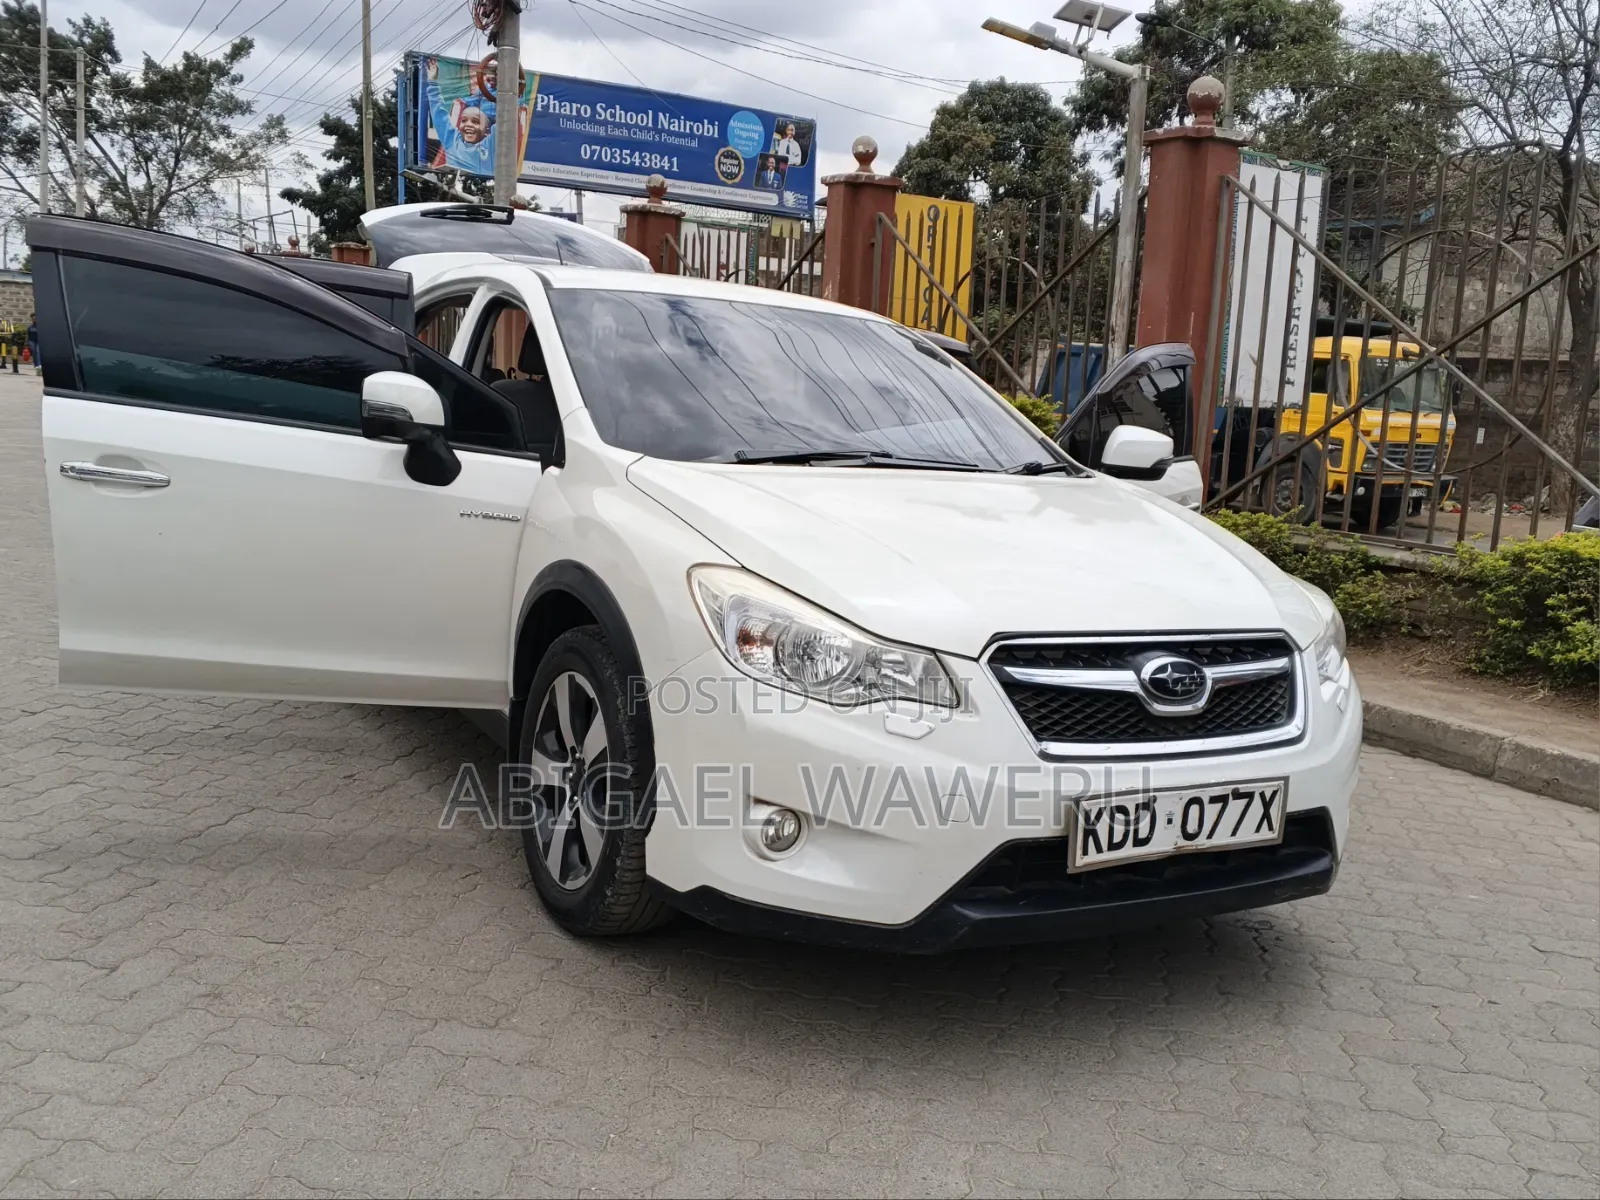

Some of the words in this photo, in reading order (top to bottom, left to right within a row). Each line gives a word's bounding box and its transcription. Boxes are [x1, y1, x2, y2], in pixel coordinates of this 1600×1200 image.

[536, 93, 591, 118] Pharo
[596, 102, 653, 127] School
[657, 111, 720, 138] Nairobi
[729, 119, 763, 131] Admissions
[559, 117, 606, 136] Unlocking
[607, 124, 629, 137] Each
[630, 127, 660, 142] Child's
[661, 132, 699, 148] Potential
[734, 128, 759, 139] Ongoing
[580, 143, 680, 172] 0703543841
[720, 156, 739, 165] Register
[720, 163, 740, 174] NOW
[531, 165, 551, 174] Quality
[552, 167, 579, 177] Education
[580, 170, 610, 180] Experience
[614, 174, 633, 183] Beyond
[690, 185, 718, 195] Leadership
[722, 190, 748, 198] Confidence
[748, 192, 774, 202] Expression
[459, 509, 521, 521] HYBRID
[1081, 801, 1157, 856] KDD
[1180, 788, 1279, 842] 077X
